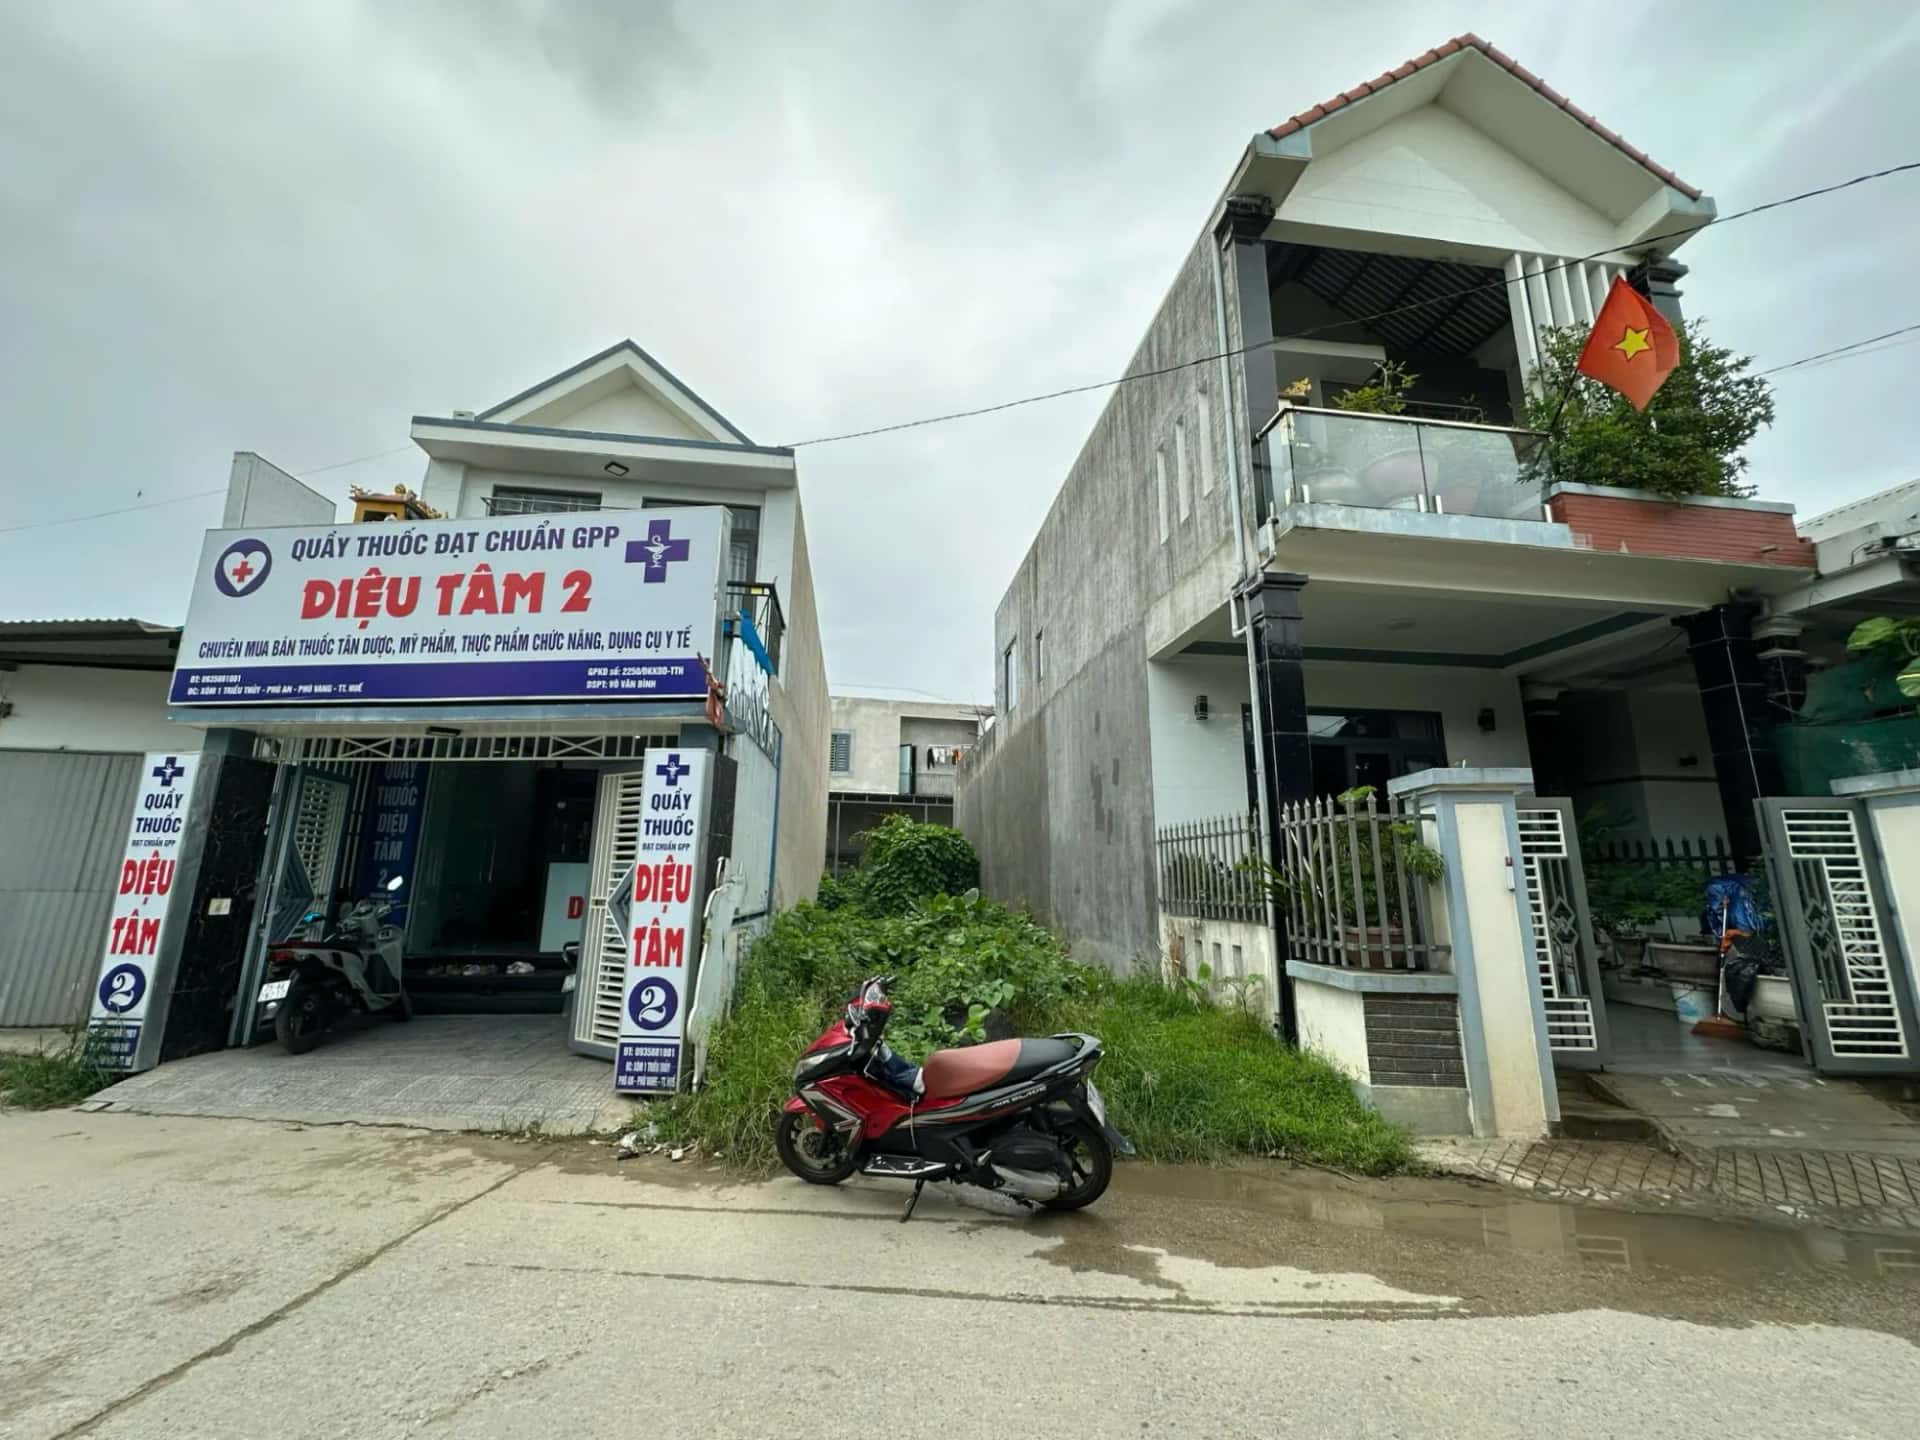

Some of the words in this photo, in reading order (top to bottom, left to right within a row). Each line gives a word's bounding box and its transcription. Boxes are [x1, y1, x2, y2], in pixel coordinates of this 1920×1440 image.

[291, 530, 349, 562] QUẦY
[358, 527, 428, 557] THUỐC
[434, 532, 479, 558] ĐẠT
[485, 520, 565, 551] CHUẨN
[572, 526, 620, 548] GPP
[300, 567, 421, 629] DIỆU
[436, 563, 546, 616] TÂM
[560, 569, 593, 612] 2
[199, 638, 243, 658] CHUYÊN
[244, 640, 269, 657] MUA
[272, 635, 296, 657] BÁN
[299, 633, 334, 656] THUỐC
[337, 634, 360, 655] TÂN
[362, 635, 395, 658] DƯỢC,
[399, 633, 419, 654] MỸ
[420, 628, 457, 655] PHẨM,
[461, 632, 492, 656] THỰC
[494, 627, 530, 652] PHẨM
[532, 629, 564, 651] CHỨC
[567, 629, 604, 653] NĂNG,
[608, 631, 642, 653] DỤNG
[645, 630, 662, 653] CỤ
[666, 630, 675, 649] Y
[676, 624, 693, 649] TẾ
[651, 787, 692, 812] QUẦY
[136, 811, 182, 833] THUỐC
[644, 813, 694, 836] THUỐC
[119, 850, 176, 905] DIỆU
[635, 854, 693, 914] DIỆU
[110, 909, 161, 955] TÂM
[633, 917, 685, 968] TÂM
[107, 972, 136, 1006] 2
[638, 985, 666, 1023] 2
